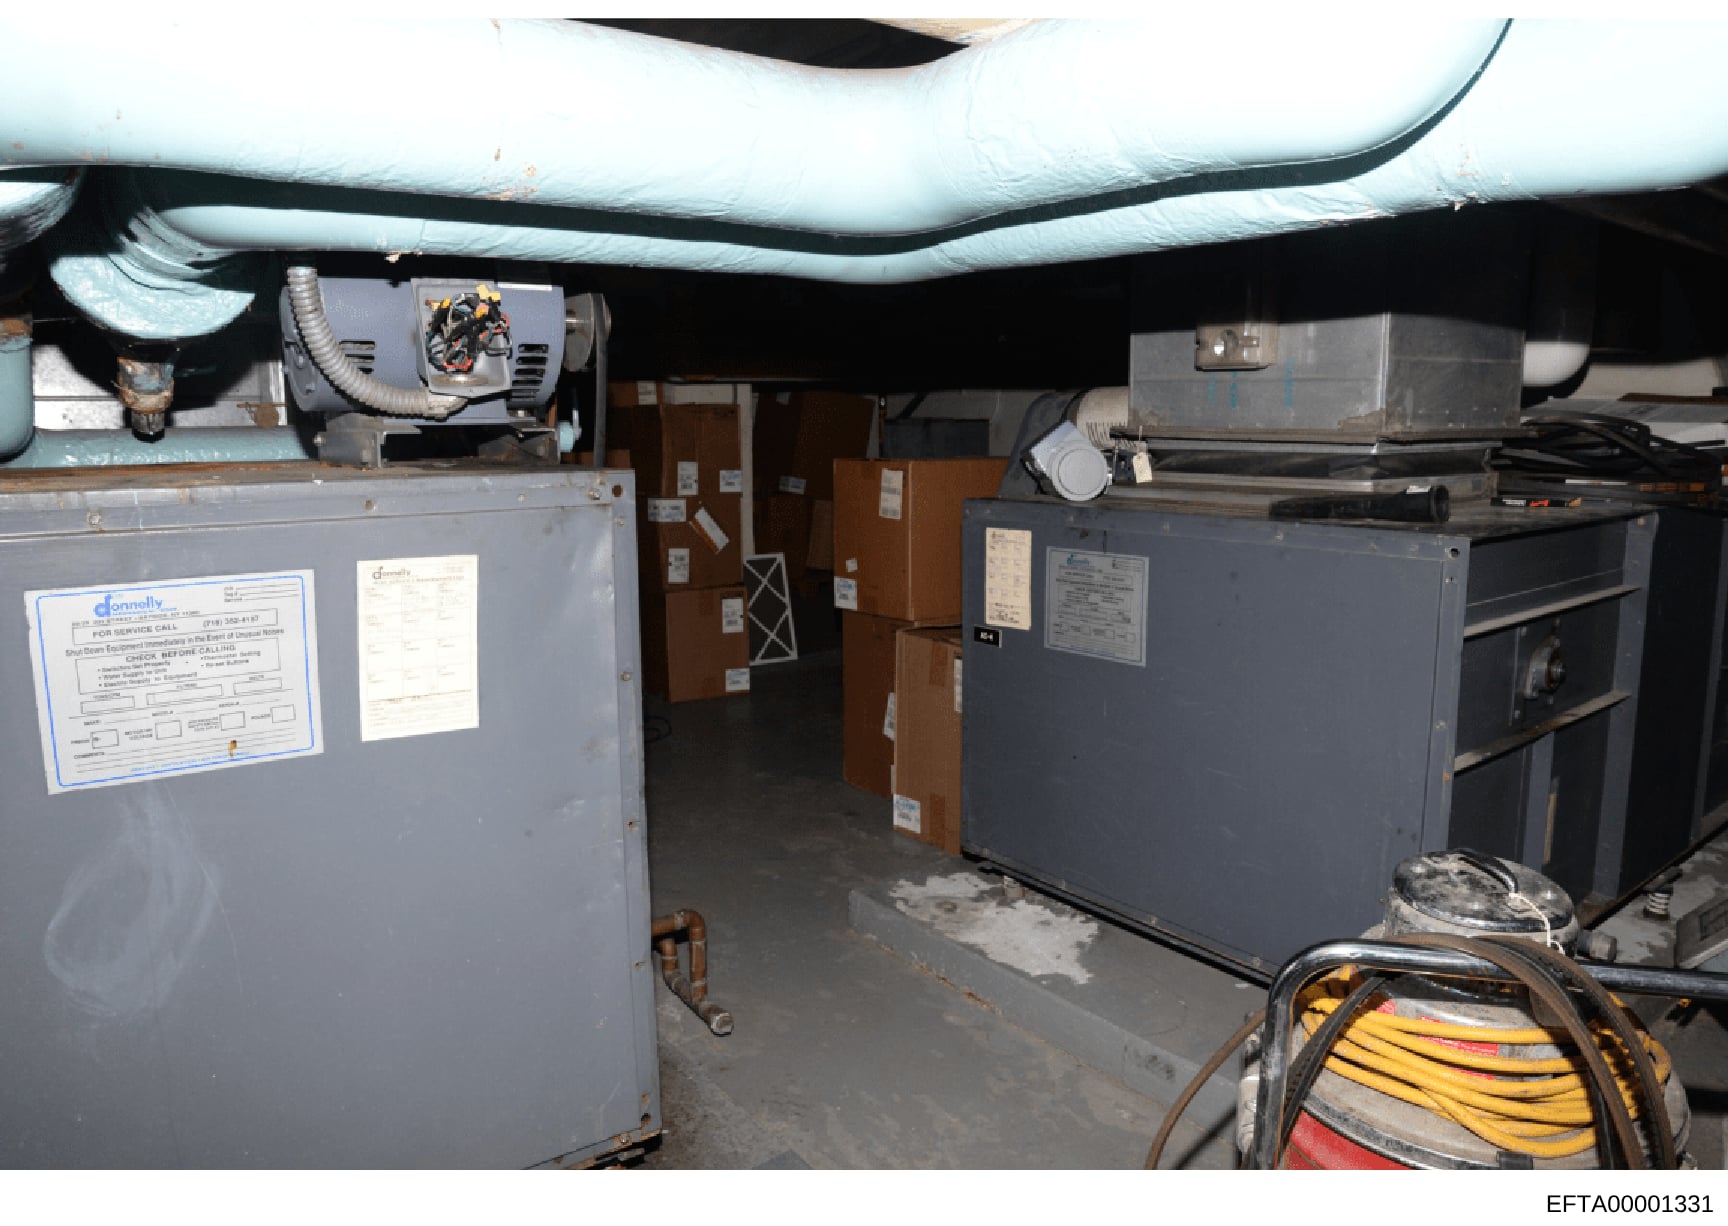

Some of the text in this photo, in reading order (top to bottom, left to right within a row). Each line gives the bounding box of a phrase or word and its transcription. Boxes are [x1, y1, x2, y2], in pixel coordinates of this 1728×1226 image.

[92, 594, 163, 617] donnelly
[92, 627, 111, 638] FOR
[113, 624, 153, 636] SERVICE
[155, 622, 178, 632] CALL
[65, 648, 83, 657] Shut
[106, 643, 143, 653] Equipment
[195, 635, 205, 643] the
[206, 633, 226, 642] Event
[235, 630, 262, 639] Unusual
[126, 653, 157, 663] CHECK
[161, 648, 197, 658] BEFORE
